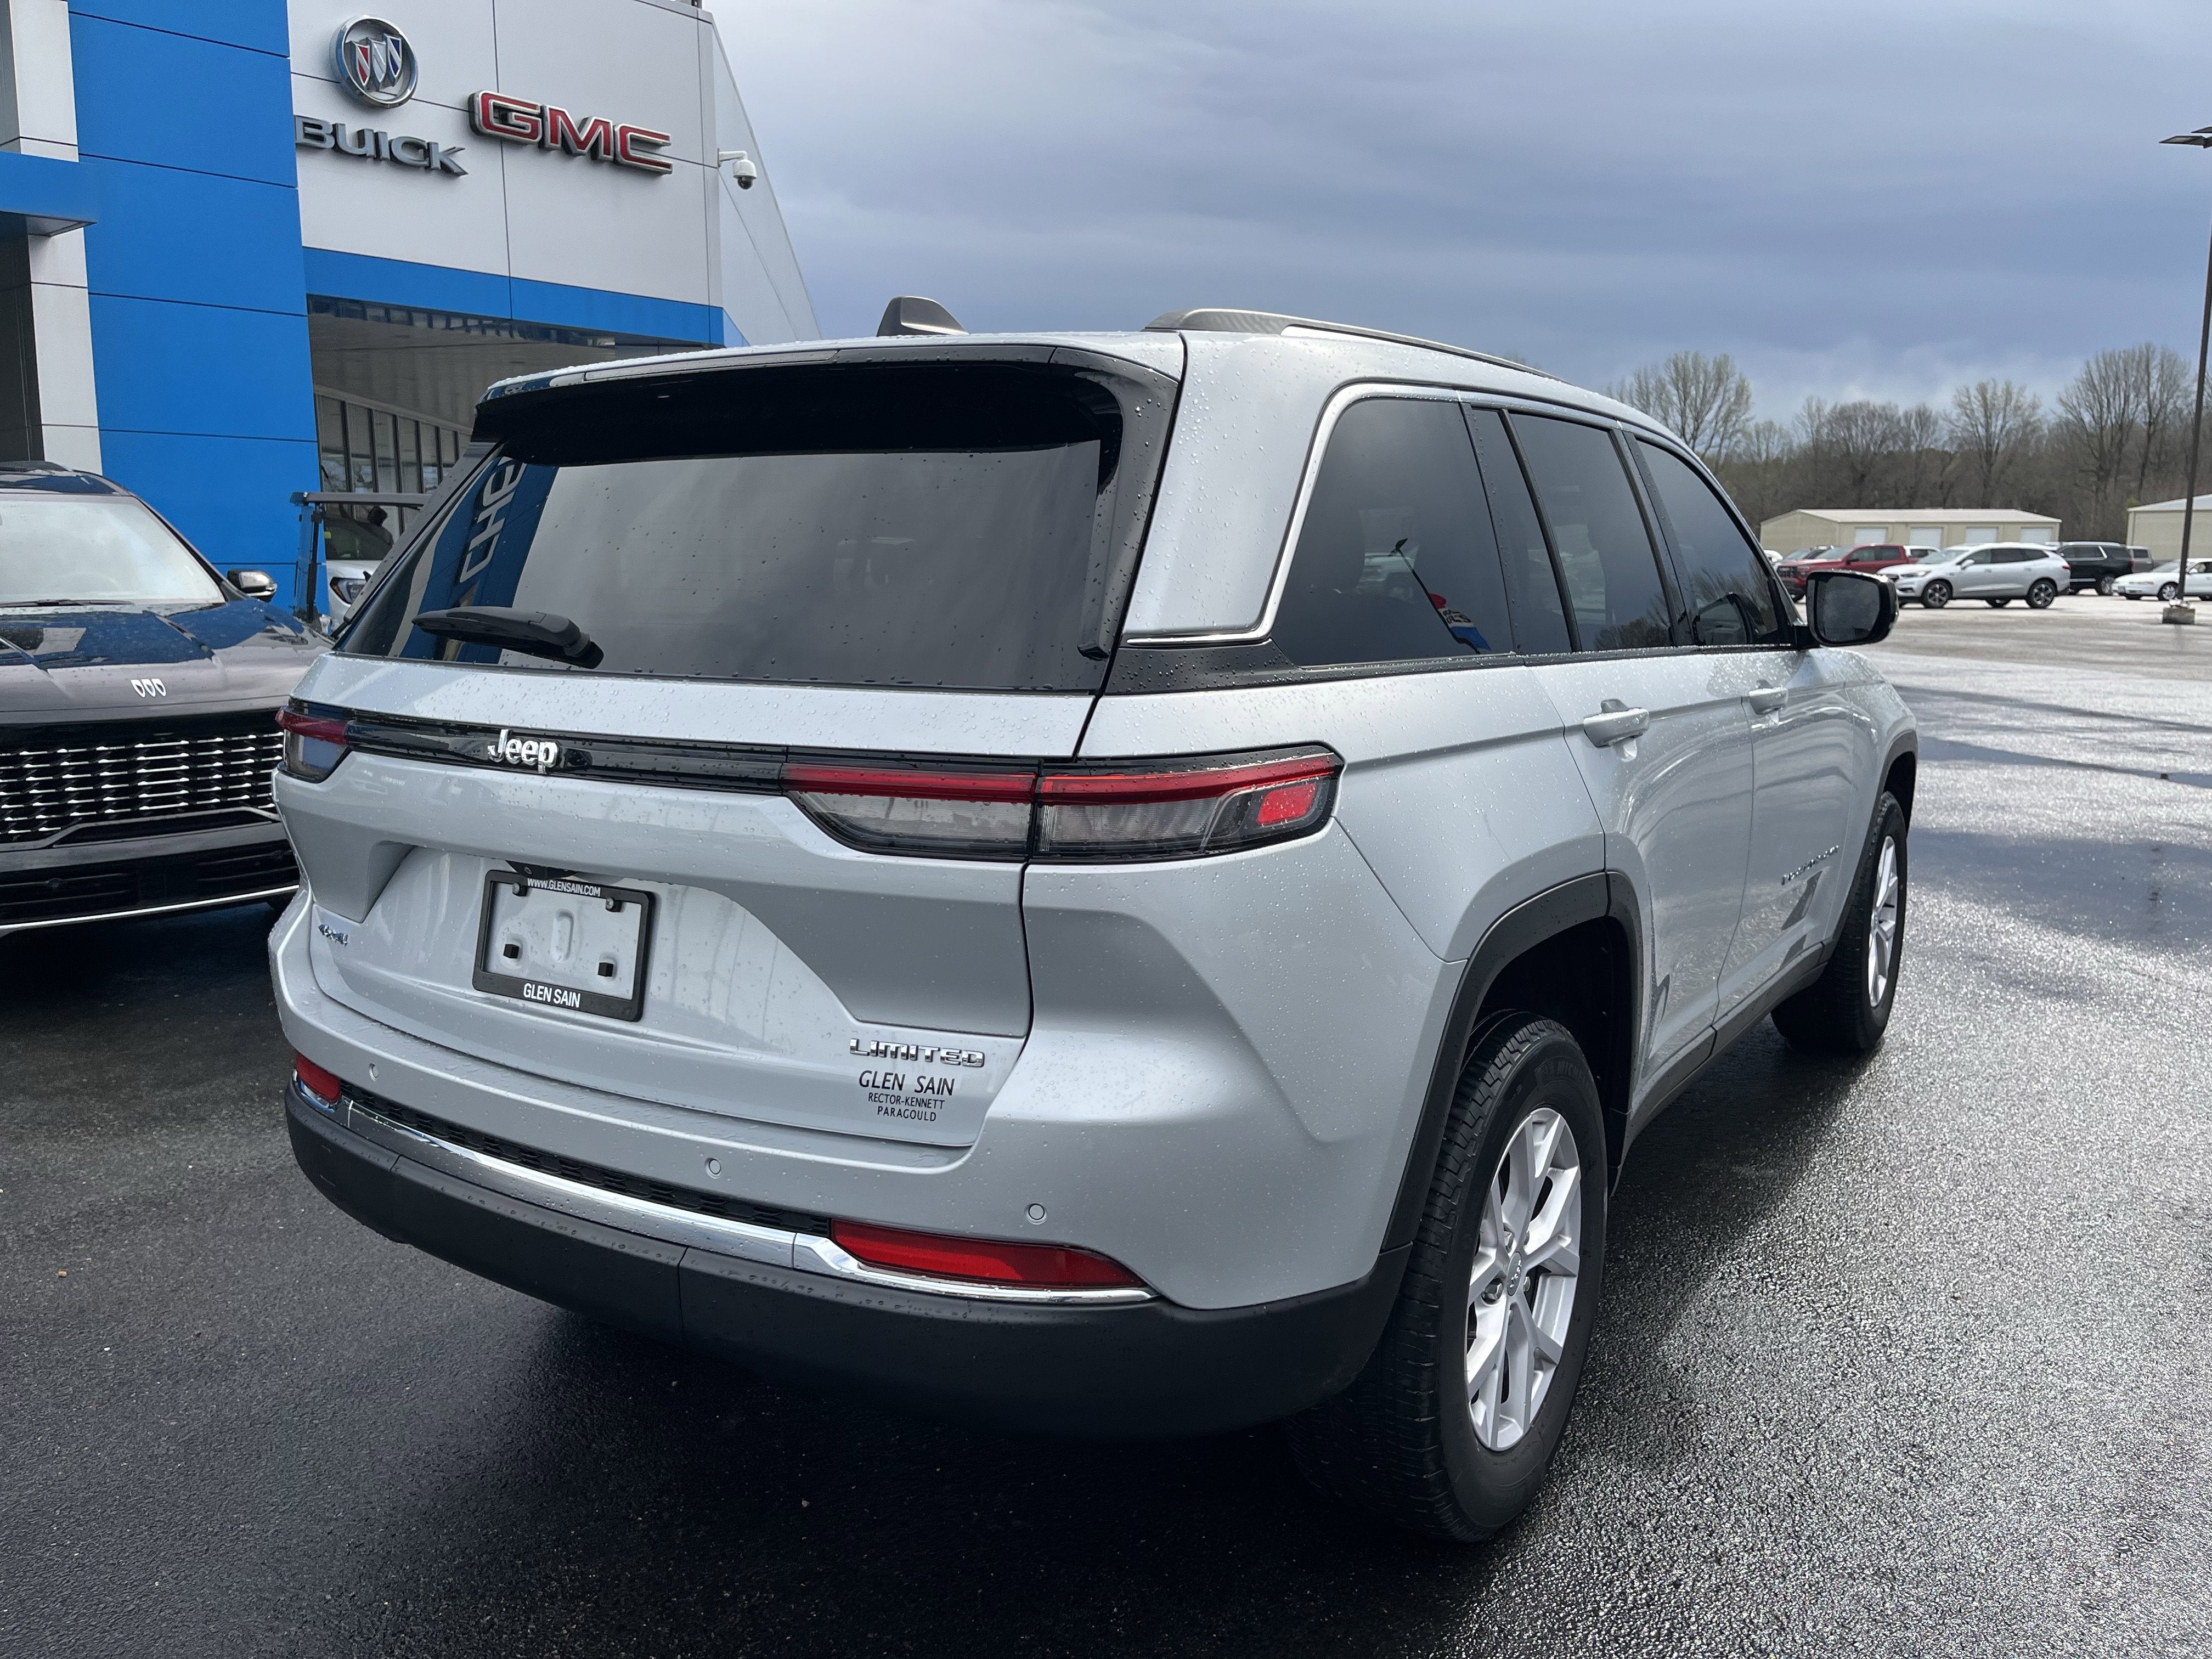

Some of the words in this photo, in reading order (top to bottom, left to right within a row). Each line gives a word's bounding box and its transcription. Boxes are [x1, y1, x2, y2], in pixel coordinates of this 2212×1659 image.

[469, 89, 673, 175] GMC
[294, 115, 469, 176] BUICK
[487, 729, 558, 774] Jeep
[527, 878, 601, 897] WWW.GLENSAIN.COM
[523, 983, 552, 1002] GLEN
[553, 989, 580, 1008] SAIN
[850, 1038, 985, 1067] LIMITED
[859, 1070, 905, 1091] GLEN
[914, 1075, 955, 1096] SAIN
[868, 1092, 945, 1110] RECTOR-KENNETT
[877, 1106, 936, 1122] PARAGOULD
